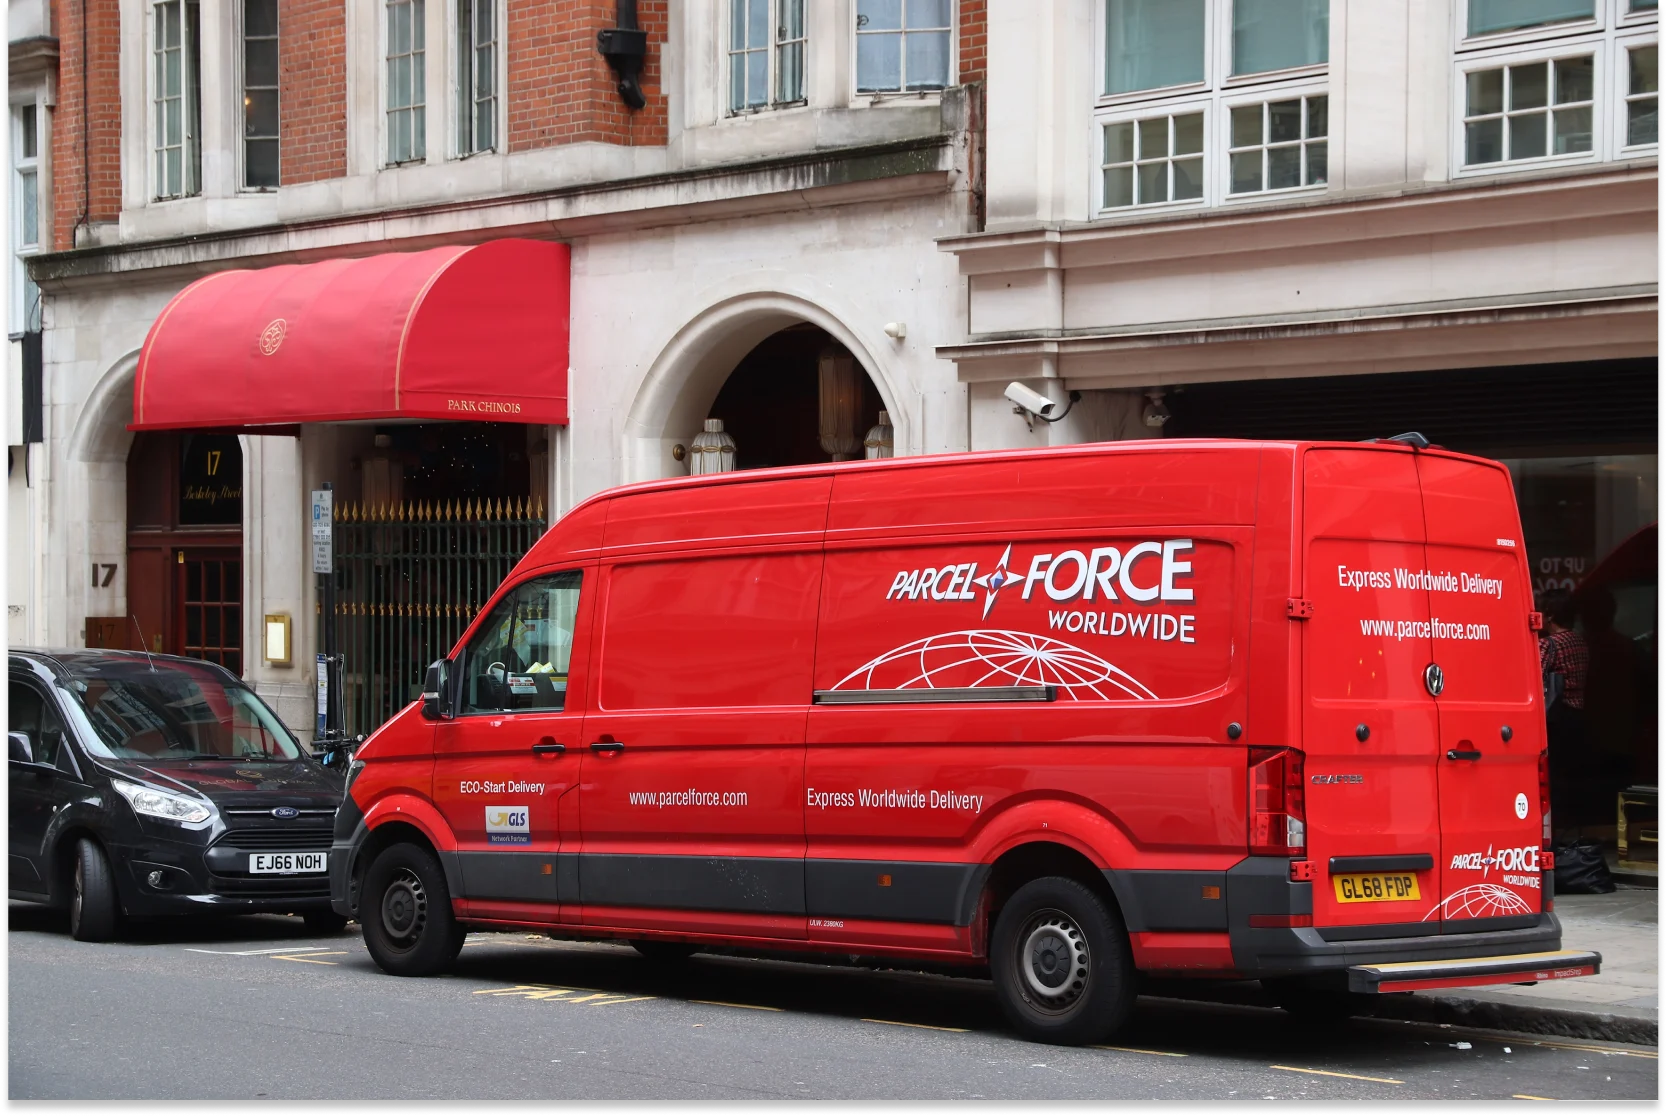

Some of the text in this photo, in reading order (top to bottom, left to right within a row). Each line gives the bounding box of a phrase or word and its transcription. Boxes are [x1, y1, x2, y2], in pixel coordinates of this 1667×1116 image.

[448, 399, 521, 413] PARK CHINOIS
[207, 451, 221, 475] 17
[92, 563, 118, 588] 17
[886, 539, 1195, 602] PARCEL FORCE
[1338, 565, 1503, 600] Express Worldwide Delivery
[1048, 610, 1196, 643] WORLDWIDE
[1359, 617, 1491, 642] www.parcelforce.com
[460, 780, 546, 796] ECO-Start Delivery
[1311, 774, 1364, 785] CRAFTER
[629, 789, 748, 809] www.parcelforce.com
[807, 788, 984, 814] Express Worldwide Delivery
[1517, 802, 1526, 812] 70
[278, 807, 295, 816] Ford
[508, 812, 526, 827] GLS
[511, 835, 528, 843] Partner
[256, 854, 322, 870] EJ66 NOH
[1450, 845, 1540, 872] PARCEL FORCE
[1341, 876, 1413, 899] GL68 FDP
[1503, 874, 1540, 889] WORLDWIDE
